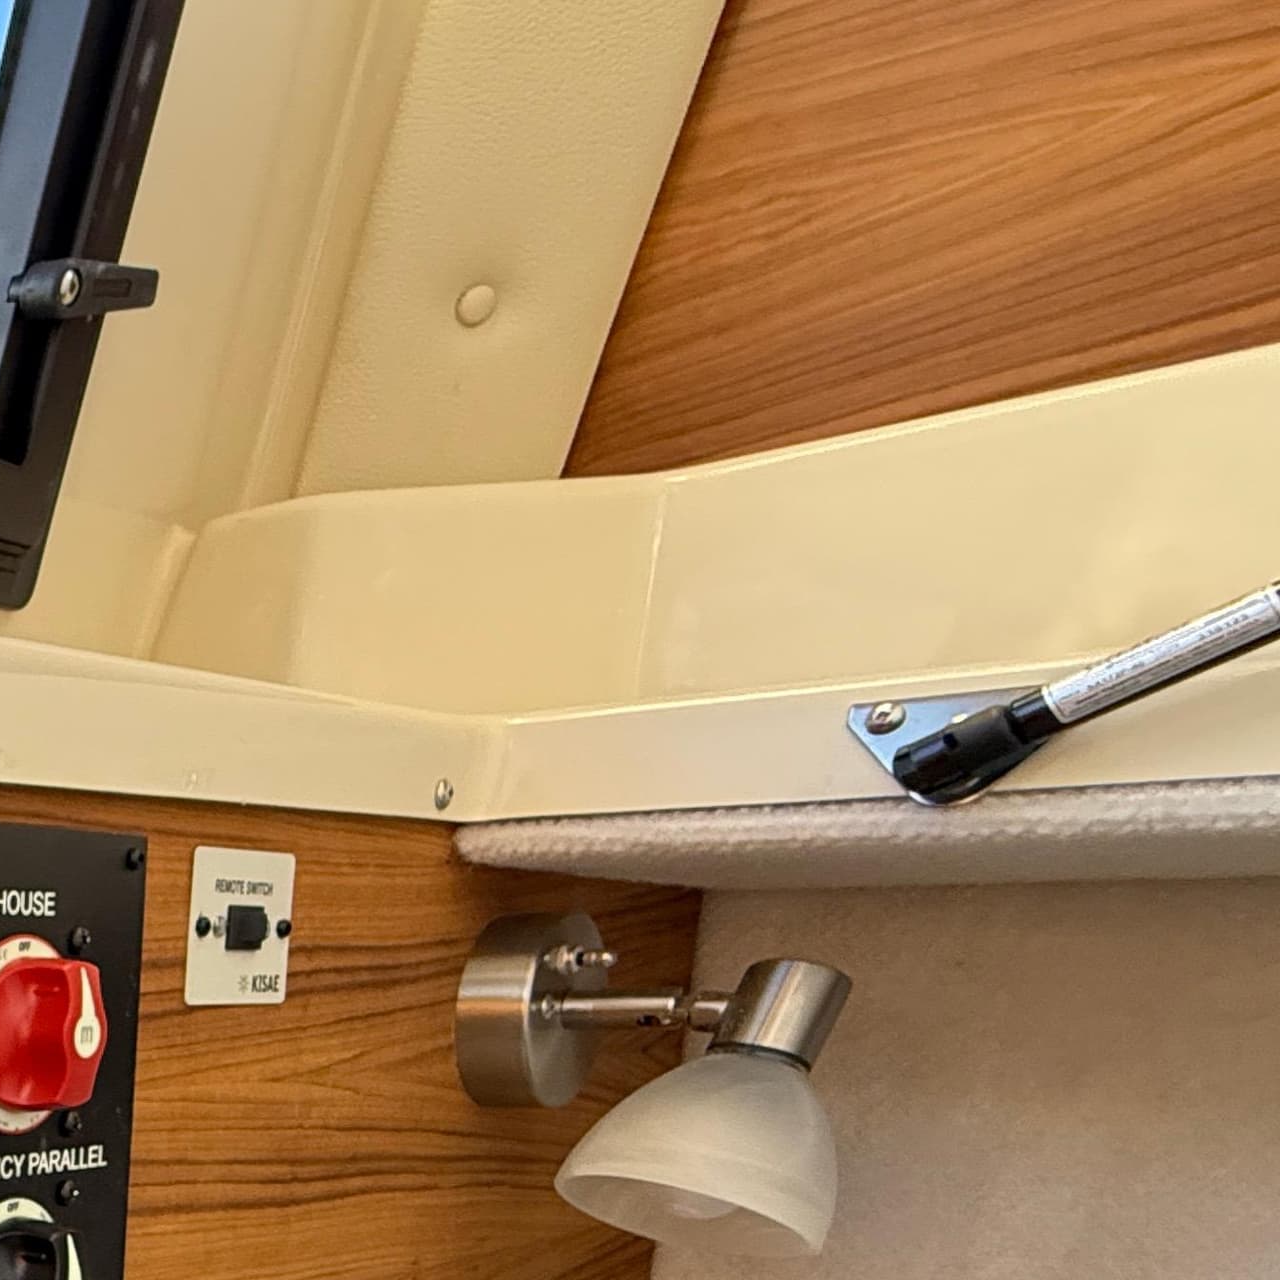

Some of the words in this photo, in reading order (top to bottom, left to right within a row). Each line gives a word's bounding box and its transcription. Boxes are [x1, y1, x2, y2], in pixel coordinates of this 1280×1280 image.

[215, 878, 245, 895] REMOTE
[246, 880, 273, 896] SWITCH
[28, 1145, 107, 1176] PARALLEL
